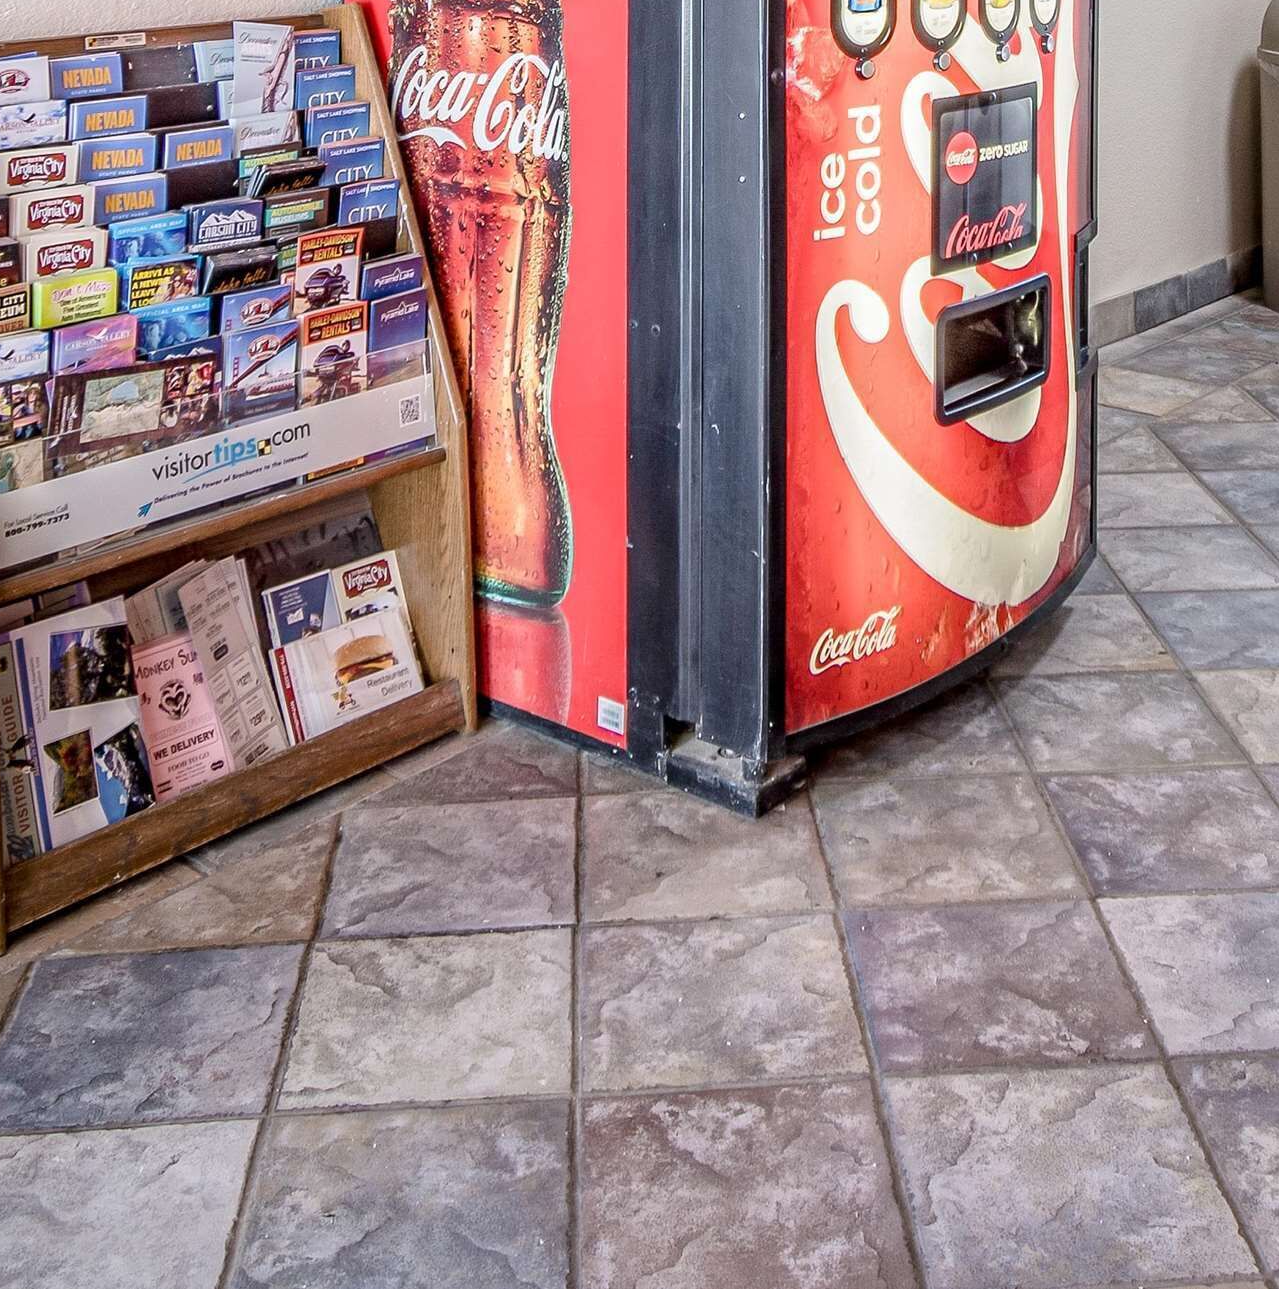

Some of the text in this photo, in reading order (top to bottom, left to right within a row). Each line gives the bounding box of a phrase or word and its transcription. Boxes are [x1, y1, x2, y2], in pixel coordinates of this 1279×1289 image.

[295, 55, 330, 68] CITY
[63, 66, 112, 88] NEVADA
[308, 90, 346, 107] CITY
[85, 109, 135, 132] NEVADA
[321, 127, 359, 145] CITY
[92, 149, 144, 170] NEVADA
[176, 139, 222, 161] NEVADA
[979, 145, 1003, 162] zero
[1004, 140, 1028, 158] SUGAR
[10, 157, 64, 180] Virginia City
[335, 164, 375, 185] CITY
[848, 105, 881, 235] cold
[105, 190, 155, 213] NEVADA
[813, 152, 846, 241] ice
[30, 200, 81, 224] Virginia City
[348, 203, 387, 225] CITY
[198, 220, 257, 240] CARSON CITY
[39, 244, 92, 269] Virginia City
[313, 246, 343, 261] RENTALS
[133, 267, 175, 280] ARRIVE AS
[399, 270, 414, 281] Lake
[3, 294, 26, 307] CITY
[404, 305, 419, 314] Lake
[321, 323, 351, 338] RENTALS
[344, 565, 389, 591] Virginia City
[367, 667, 409, 689] Restaurant
[381, 679, 413, 697] Delivery
[1, 696, 18, 743] GUIDE
[153, 729, 215, 760] WE DELIVERY
[13, 775, 30, 833] VISITOR
